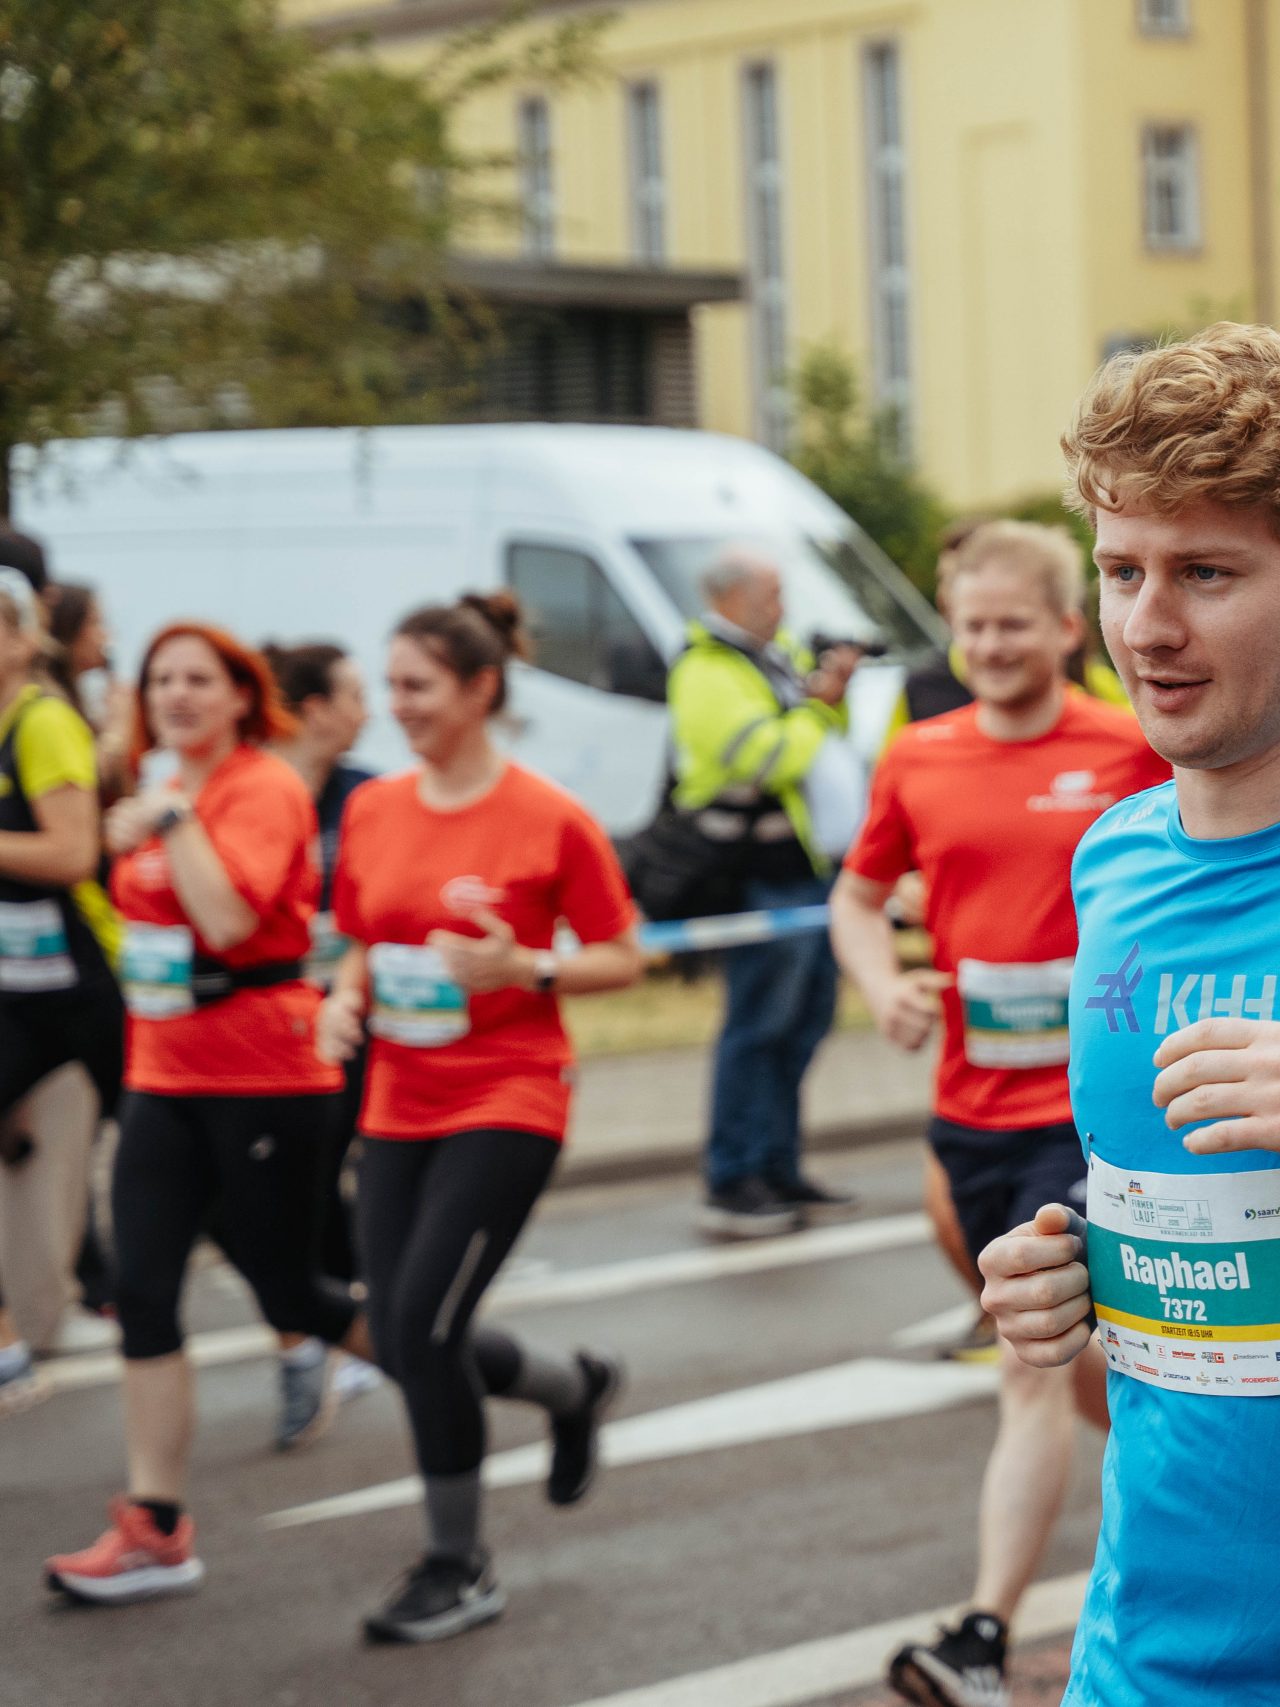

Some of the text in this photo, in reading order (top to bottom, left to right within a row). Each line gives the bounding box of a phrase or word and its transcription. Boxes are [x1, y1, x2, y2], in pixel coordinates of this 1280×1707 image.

[1129, 1179, 1141, 1189] dm
[1131, 1199, 1154, 1210] FIRMEN
[1133, 1209, 1155, 1224] LAUF
[1119, 1244, 1250, 1294] Raphael
[1160, 1297, 1207, 1321] 7372
[1161, 1325, 1186, 1336] STARTZEIT
[1201, 1329, 1213, 1339] UHR
